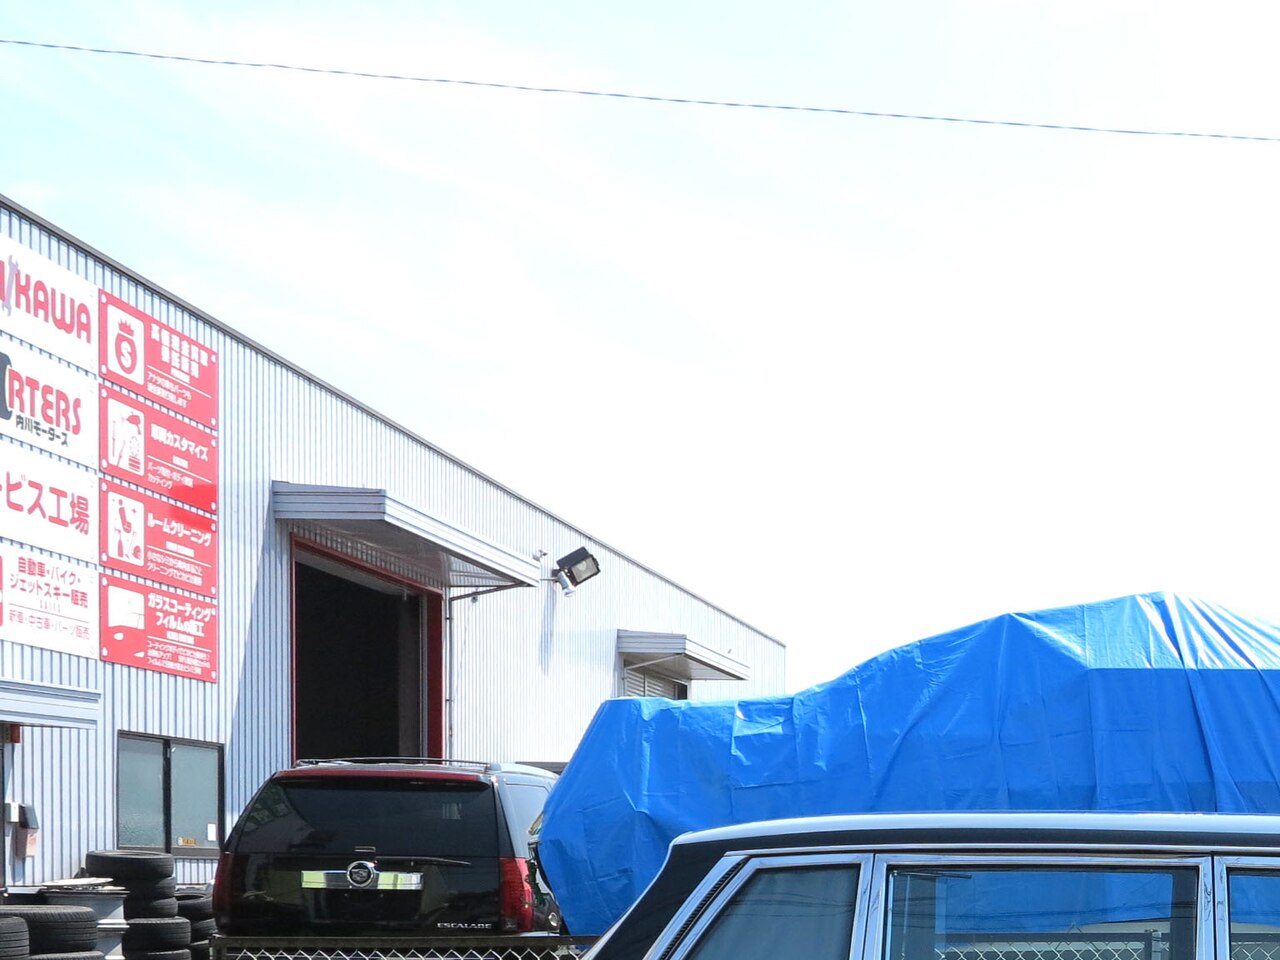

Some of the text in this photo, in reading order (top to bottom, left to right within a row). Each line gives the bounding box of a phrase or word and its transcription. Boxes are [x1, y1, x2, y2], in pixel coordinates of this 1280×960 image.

[16, 414, 69, 447] 内川モータース
[0, 471, 90, 536] ビス工場
[147, 513, 212, 547] ルームクリーニング
[10, 574, 88, 608] ジェットスキー販売
[148, 592, 212, 622] ガラスコーティング
